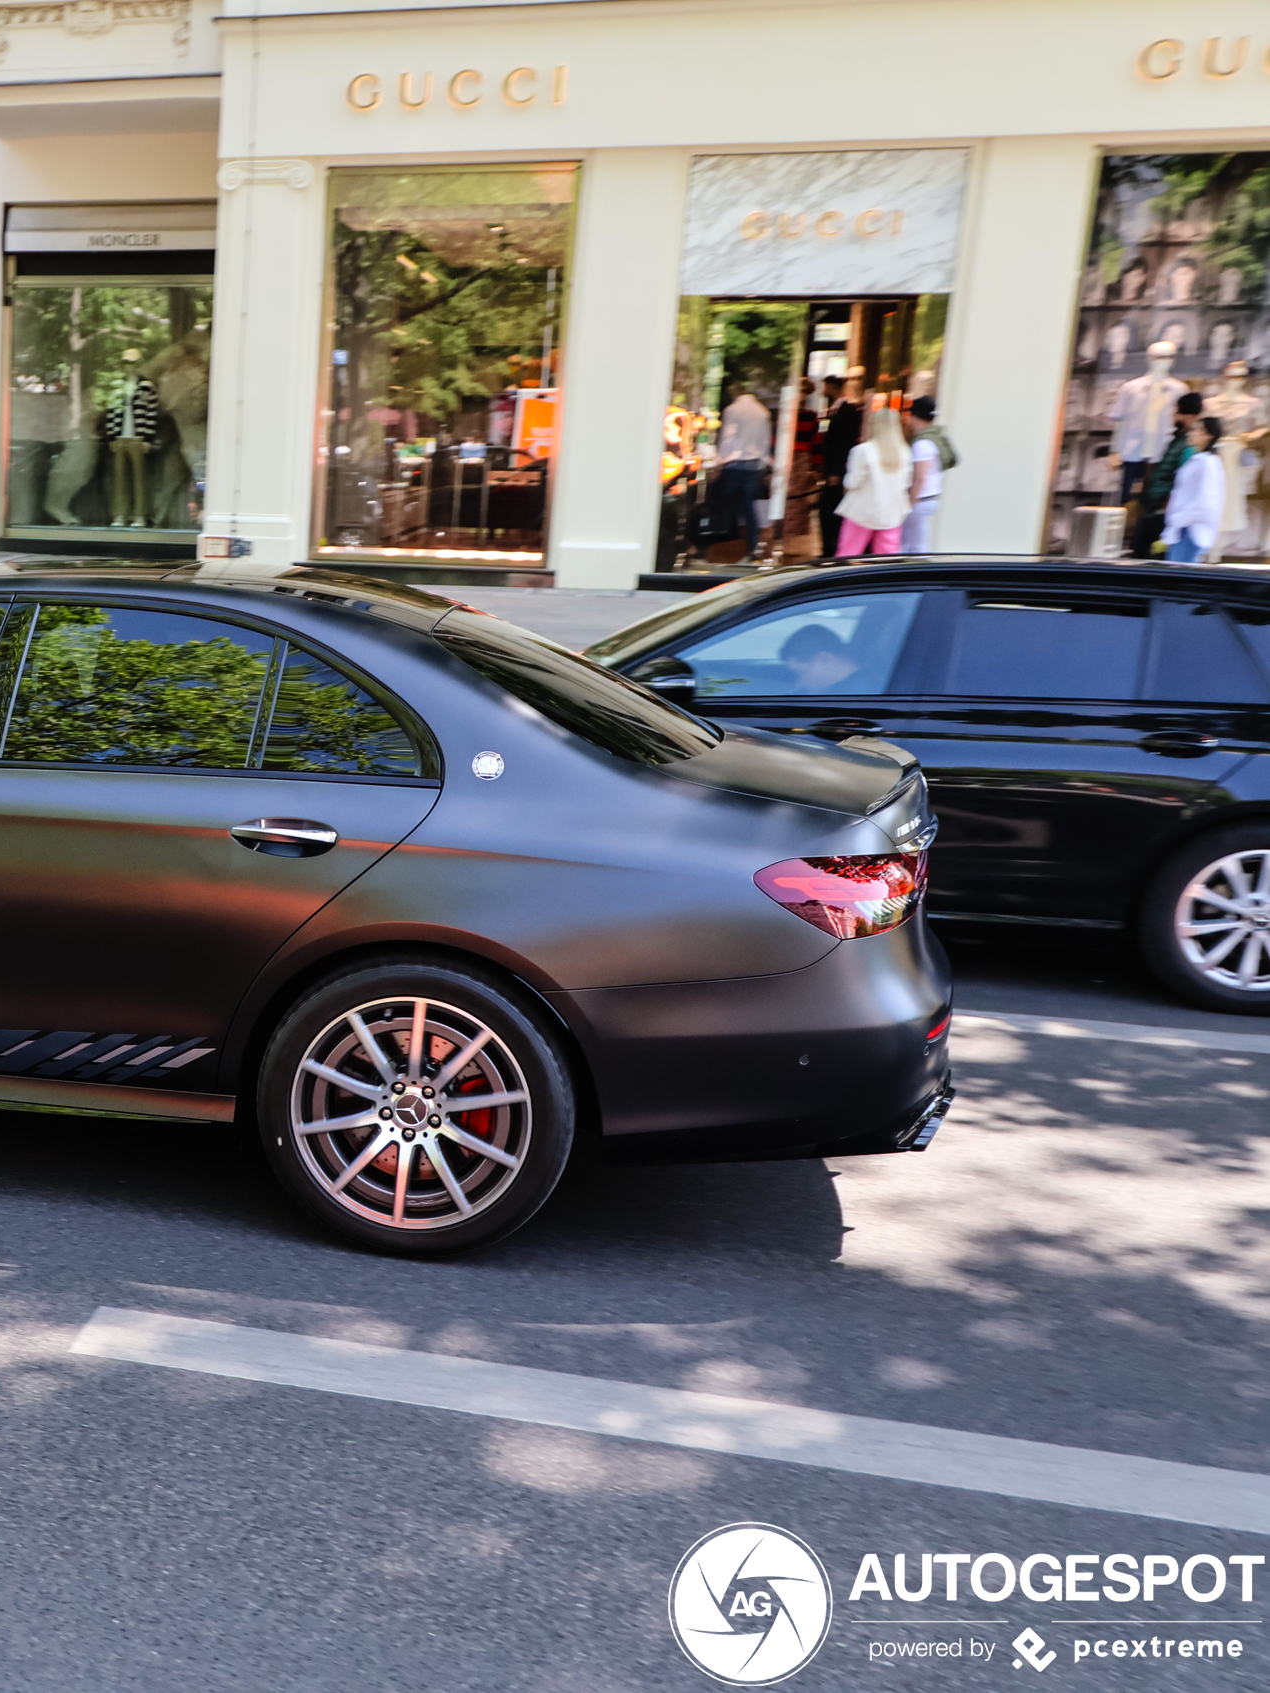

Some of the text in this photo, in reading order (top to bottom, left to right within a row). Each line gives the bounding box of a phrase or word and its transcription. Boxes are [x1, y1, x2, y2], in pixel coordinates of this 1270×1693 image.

[1134, 35, 1270, 81] GU
[345, 65, 569, 110] GUCCI
[87, 233, 162, 247] MONCLER
[740, 208, 904, 240] GUCCI
